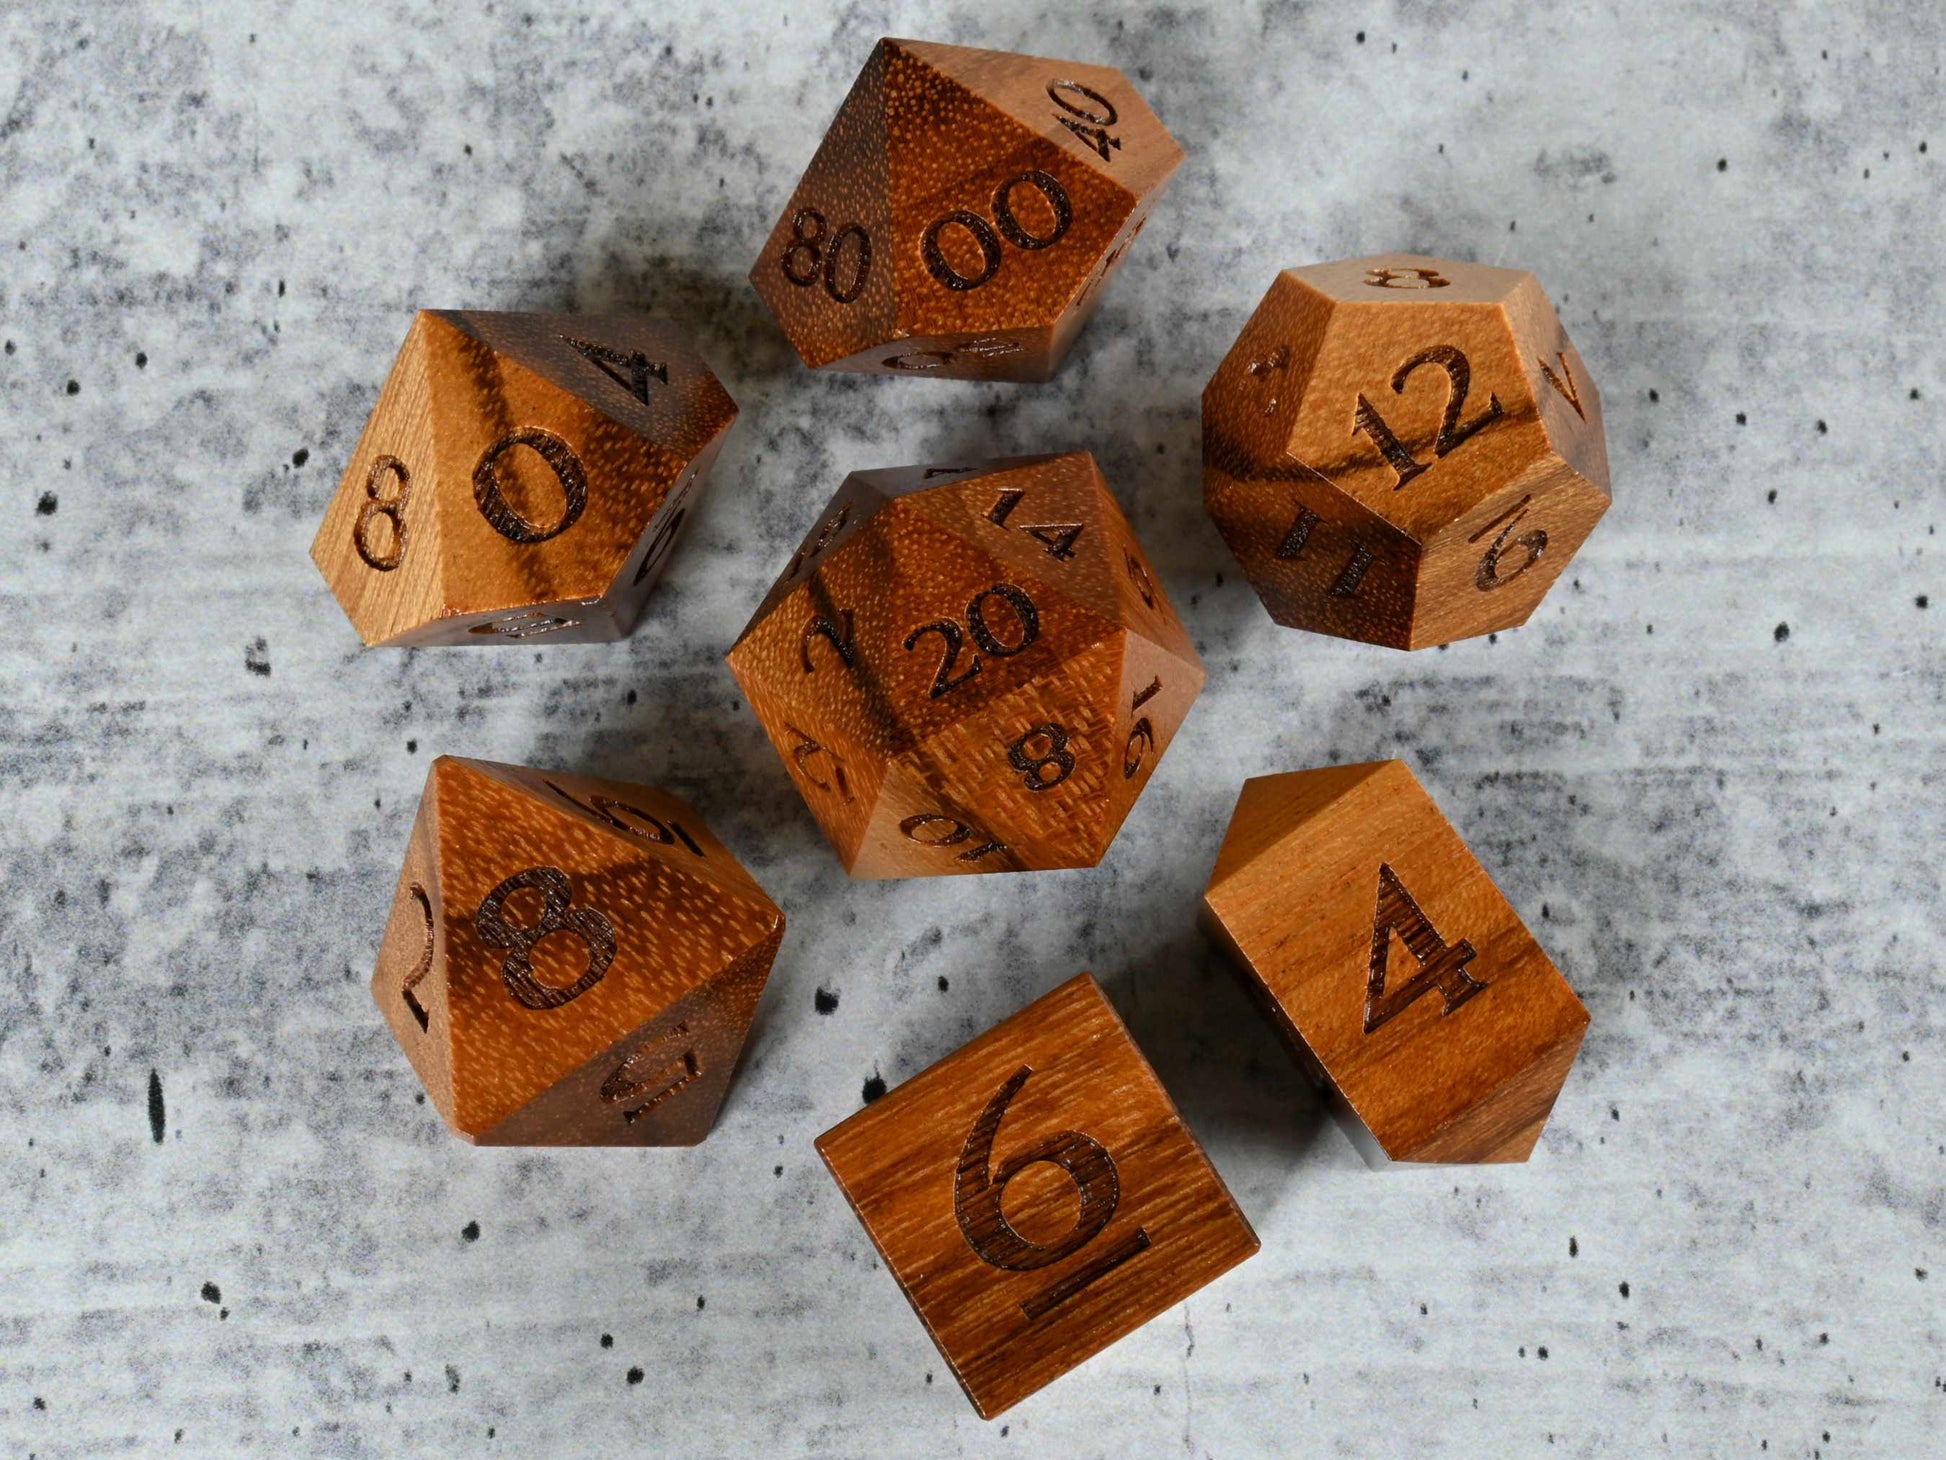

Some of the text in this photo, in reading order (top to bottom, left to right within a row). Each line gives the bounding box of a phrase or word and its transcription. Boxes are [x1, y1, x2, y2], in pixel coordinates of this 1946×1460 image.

[1046, 78, 1122, 163] 40
[780, 206, 872, 304] 80
[919, 168, 1073, 290] 00
[1364, 267, 1451, 290] 8
[560, 333, 669, 407] 4
[1352, 344, 1506, 491] 12
[353, 454, 411, 572] 8
[472, 424, 589, 544] 0
[980, 486, 1084, 562] 14
[1274, 499, 1378, 600] 11
[902, 582, 1041, 700] 20
[1008, 721, 1076, 792] 8
[899, 812, 1009, 864] 10
[401, 881, 434, 1034] 2
[475, 865, 618, 1011] 8
[1363, 862, 1489, 1035] 4
